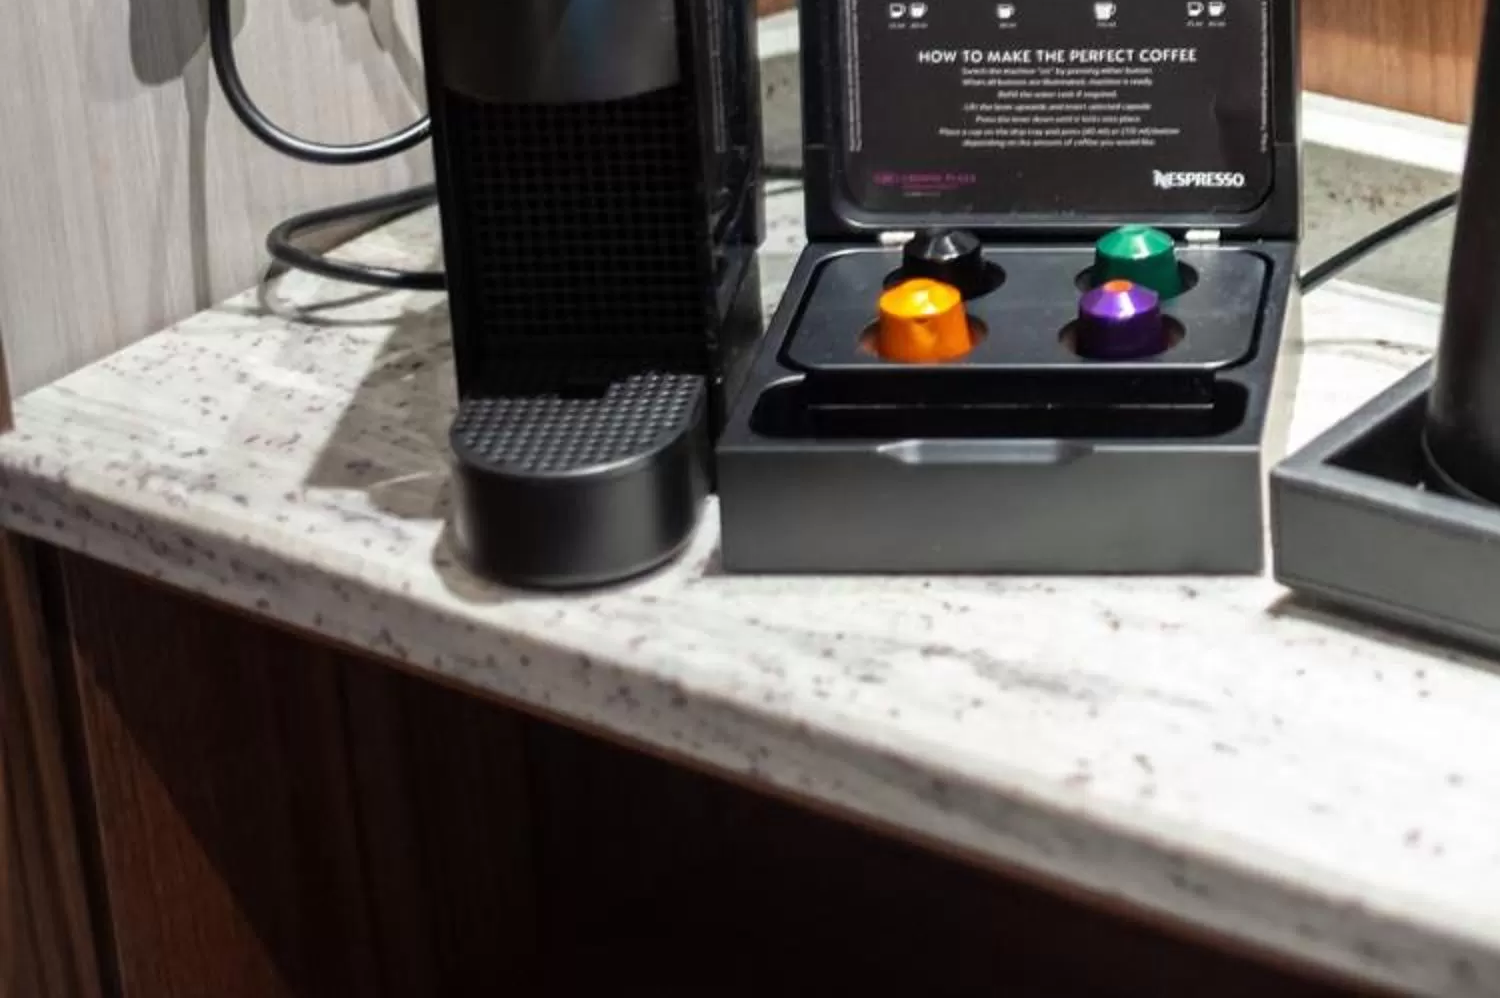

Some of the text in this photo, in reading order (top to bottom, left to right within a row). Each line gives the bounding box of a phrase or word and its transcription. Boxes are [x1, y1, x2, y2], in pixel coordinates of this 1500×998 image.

[918, 49, 1197, 63] HOW TO MAKE THE PERFECT COFFEE
[1153, 169, 1246, 189] NESPRESSO
